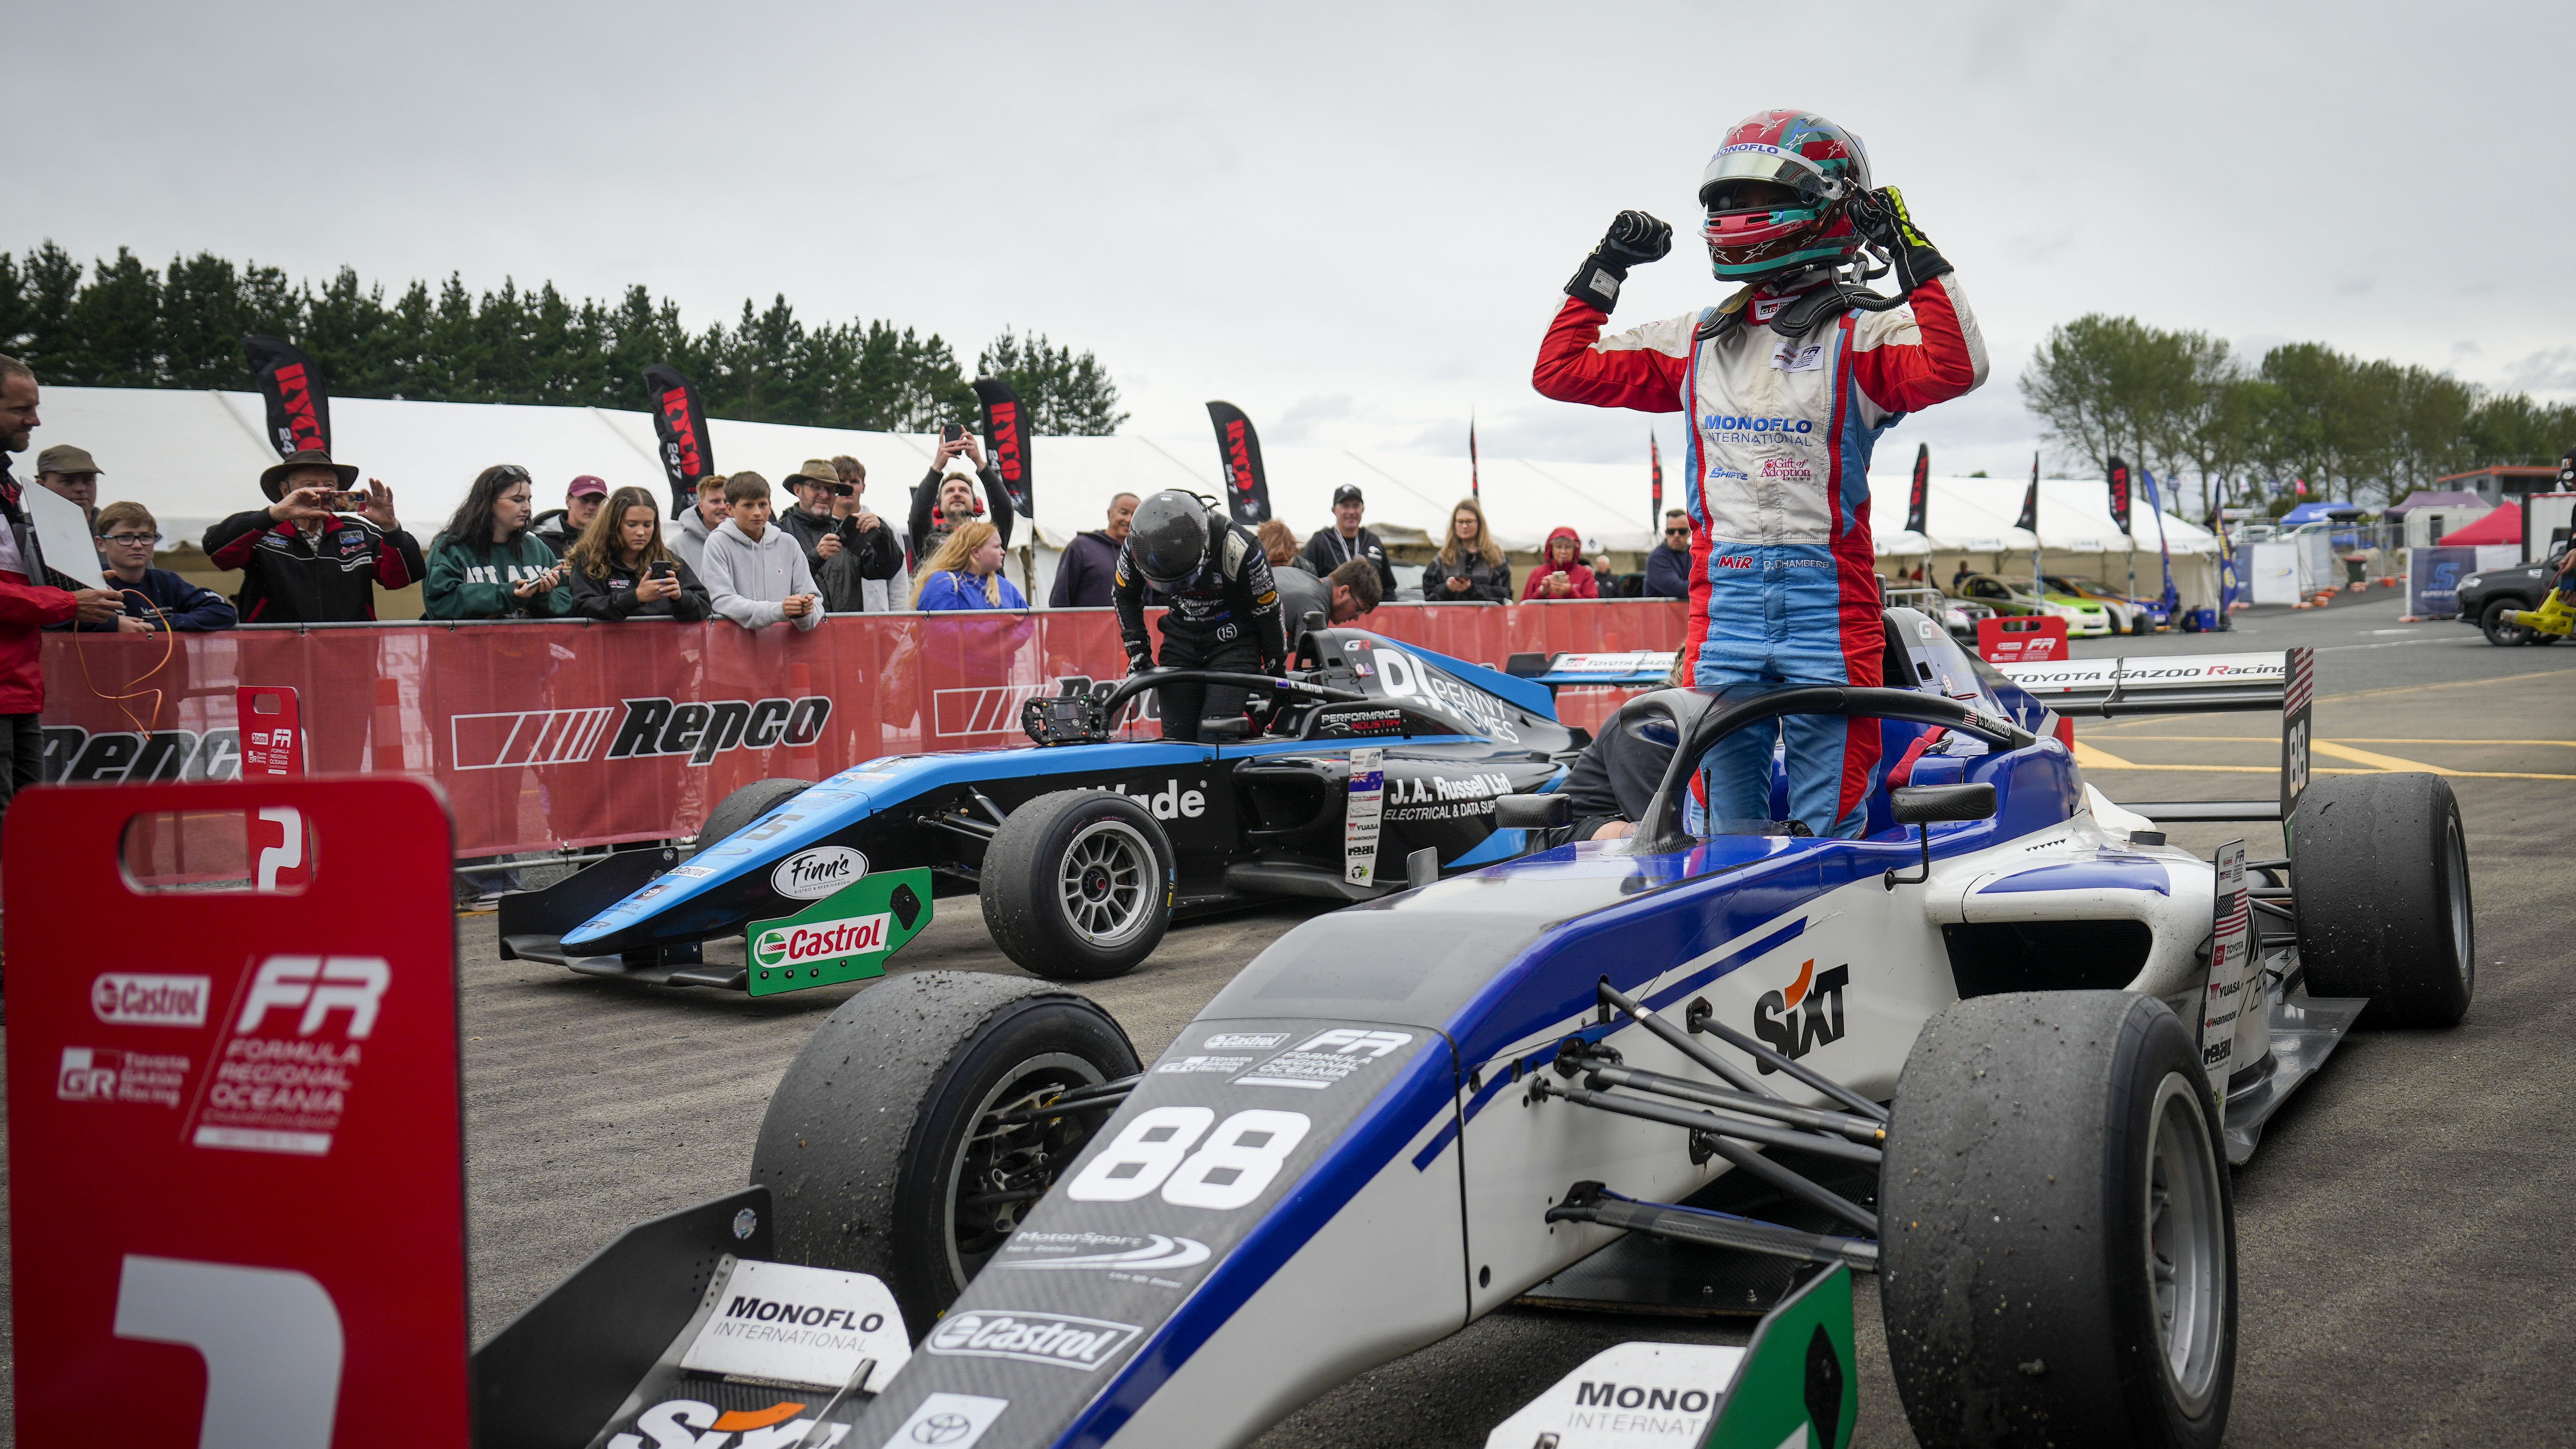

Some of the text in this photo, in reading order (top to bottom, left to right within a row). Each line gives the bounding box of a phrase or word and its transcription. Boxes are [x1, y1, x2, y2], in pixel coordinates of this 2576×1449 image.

[1711, 144, 1779, 161] MONOFLO
[662, 387, 697, 476] RYCO
[1704, 415, 1813, 434] MONOFLO
[990, 401, 1022, 480] RYCO
[1707, 432, 1813, 447] NTERNATIONAL
[666, 442, 683, 480] 247
[1227, 419, 1254, 491] RYCO
[1774, 458, 1808, 468] Gift of
[1761, 467, 1811, 481] Adoption
[1222, 626, 1233, 639] 15
[1344, 639, 1371, 652] GR
[2010, 665, 2287, 683] TOYOTA GAZOO Racing
[1299, 683, 1323, 694] NGATOA
[1431, 677, 1506, 719] PENNY
[1322, 709, 1401, 724] PERFORMANCE
[1351, 719, 1402, 730] INDUSTRY
[1984, 714, 2011, 737] CHAMBERS
[272, 728, 292, 748] FR
[604, 696, 833, 767] Repco
[2289, 719, 2307, 798] 88
[1433, 774, 1490, 802] Russell
[1483, 772, 1514, 795] Ltd
[1383, 805, 1453, 821] ELECTRICAL
[1452, 804, 1459, 817] &
[1460, 801, 1481, 817] DATA
[1357, 823, 1379, 831] YUASA
[1348, 845, 1374, 856] real
[791, 854, 850, 887] Finn's
[1061, 854, 1071, 882] RACING
[1149, 886, 1158, 914] RACING
[789, 918, 880, 959] Castrol
[2226, 940, 2244, 955] TOYOTA
[2224, 953, 2236, 962] Financial
[236, 954, 393, 1039] FR
[2219, 979, 2240, 998] YUASA
[120, 981, 200, 1017] Castrol
[1223, 1034, 1281, 1047] Castrol
[1293, 1028, 1413, 1057] FR
[225, 1038, 361, 1066] FORMULA
[1280, 1051, 1374, 1065] FORMULA
[2203, 1037, 2232, 1065] real
[1258, 1063, 1350, 1078] OCEANIA
[1270, 1057, 1359, 1072] REGIONAL
[217, 1062, 352, 1089] REGIONAL
[1245, 1071, 1342, 1081] CHAMPIONSHIP
[210, 1087, 344, 1113] OCEANIA
[1067, 1106, 1312, 1210] 88
[1015, 1231, 1143, 1247] MotorSport
[1033, 1244, 1078, 1254] Zealand
[725, 1296, 884, 1333] MONOFLO
[713, 1321, 867, 1353] INTERNATIONAL
[974, 1315, 1120, 1365] Castrol
